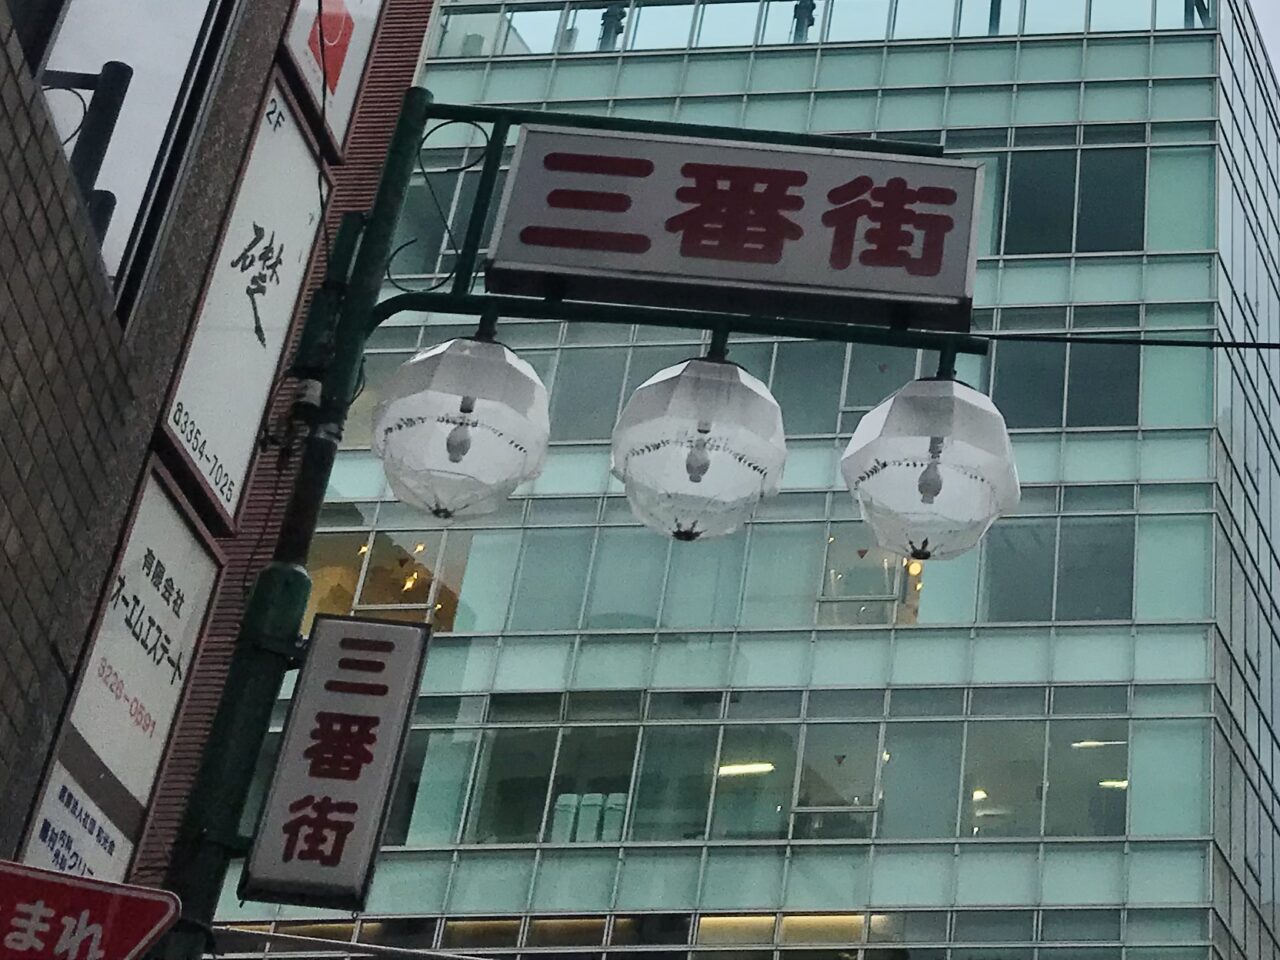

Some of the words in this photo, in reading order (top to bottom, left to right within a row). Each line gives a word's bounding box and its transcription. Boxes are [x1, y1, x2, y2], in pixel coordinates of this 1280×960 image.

[265, 97, 286, 132] 2F
[518, 151, 959, 278] 三番街
[141, 546, 185, 620] 有限会社
[110, 574, 183, 686] オーエムエステート
[281, 637, 396, 868] 三番街
[4, 900, 105, 960] まれ
